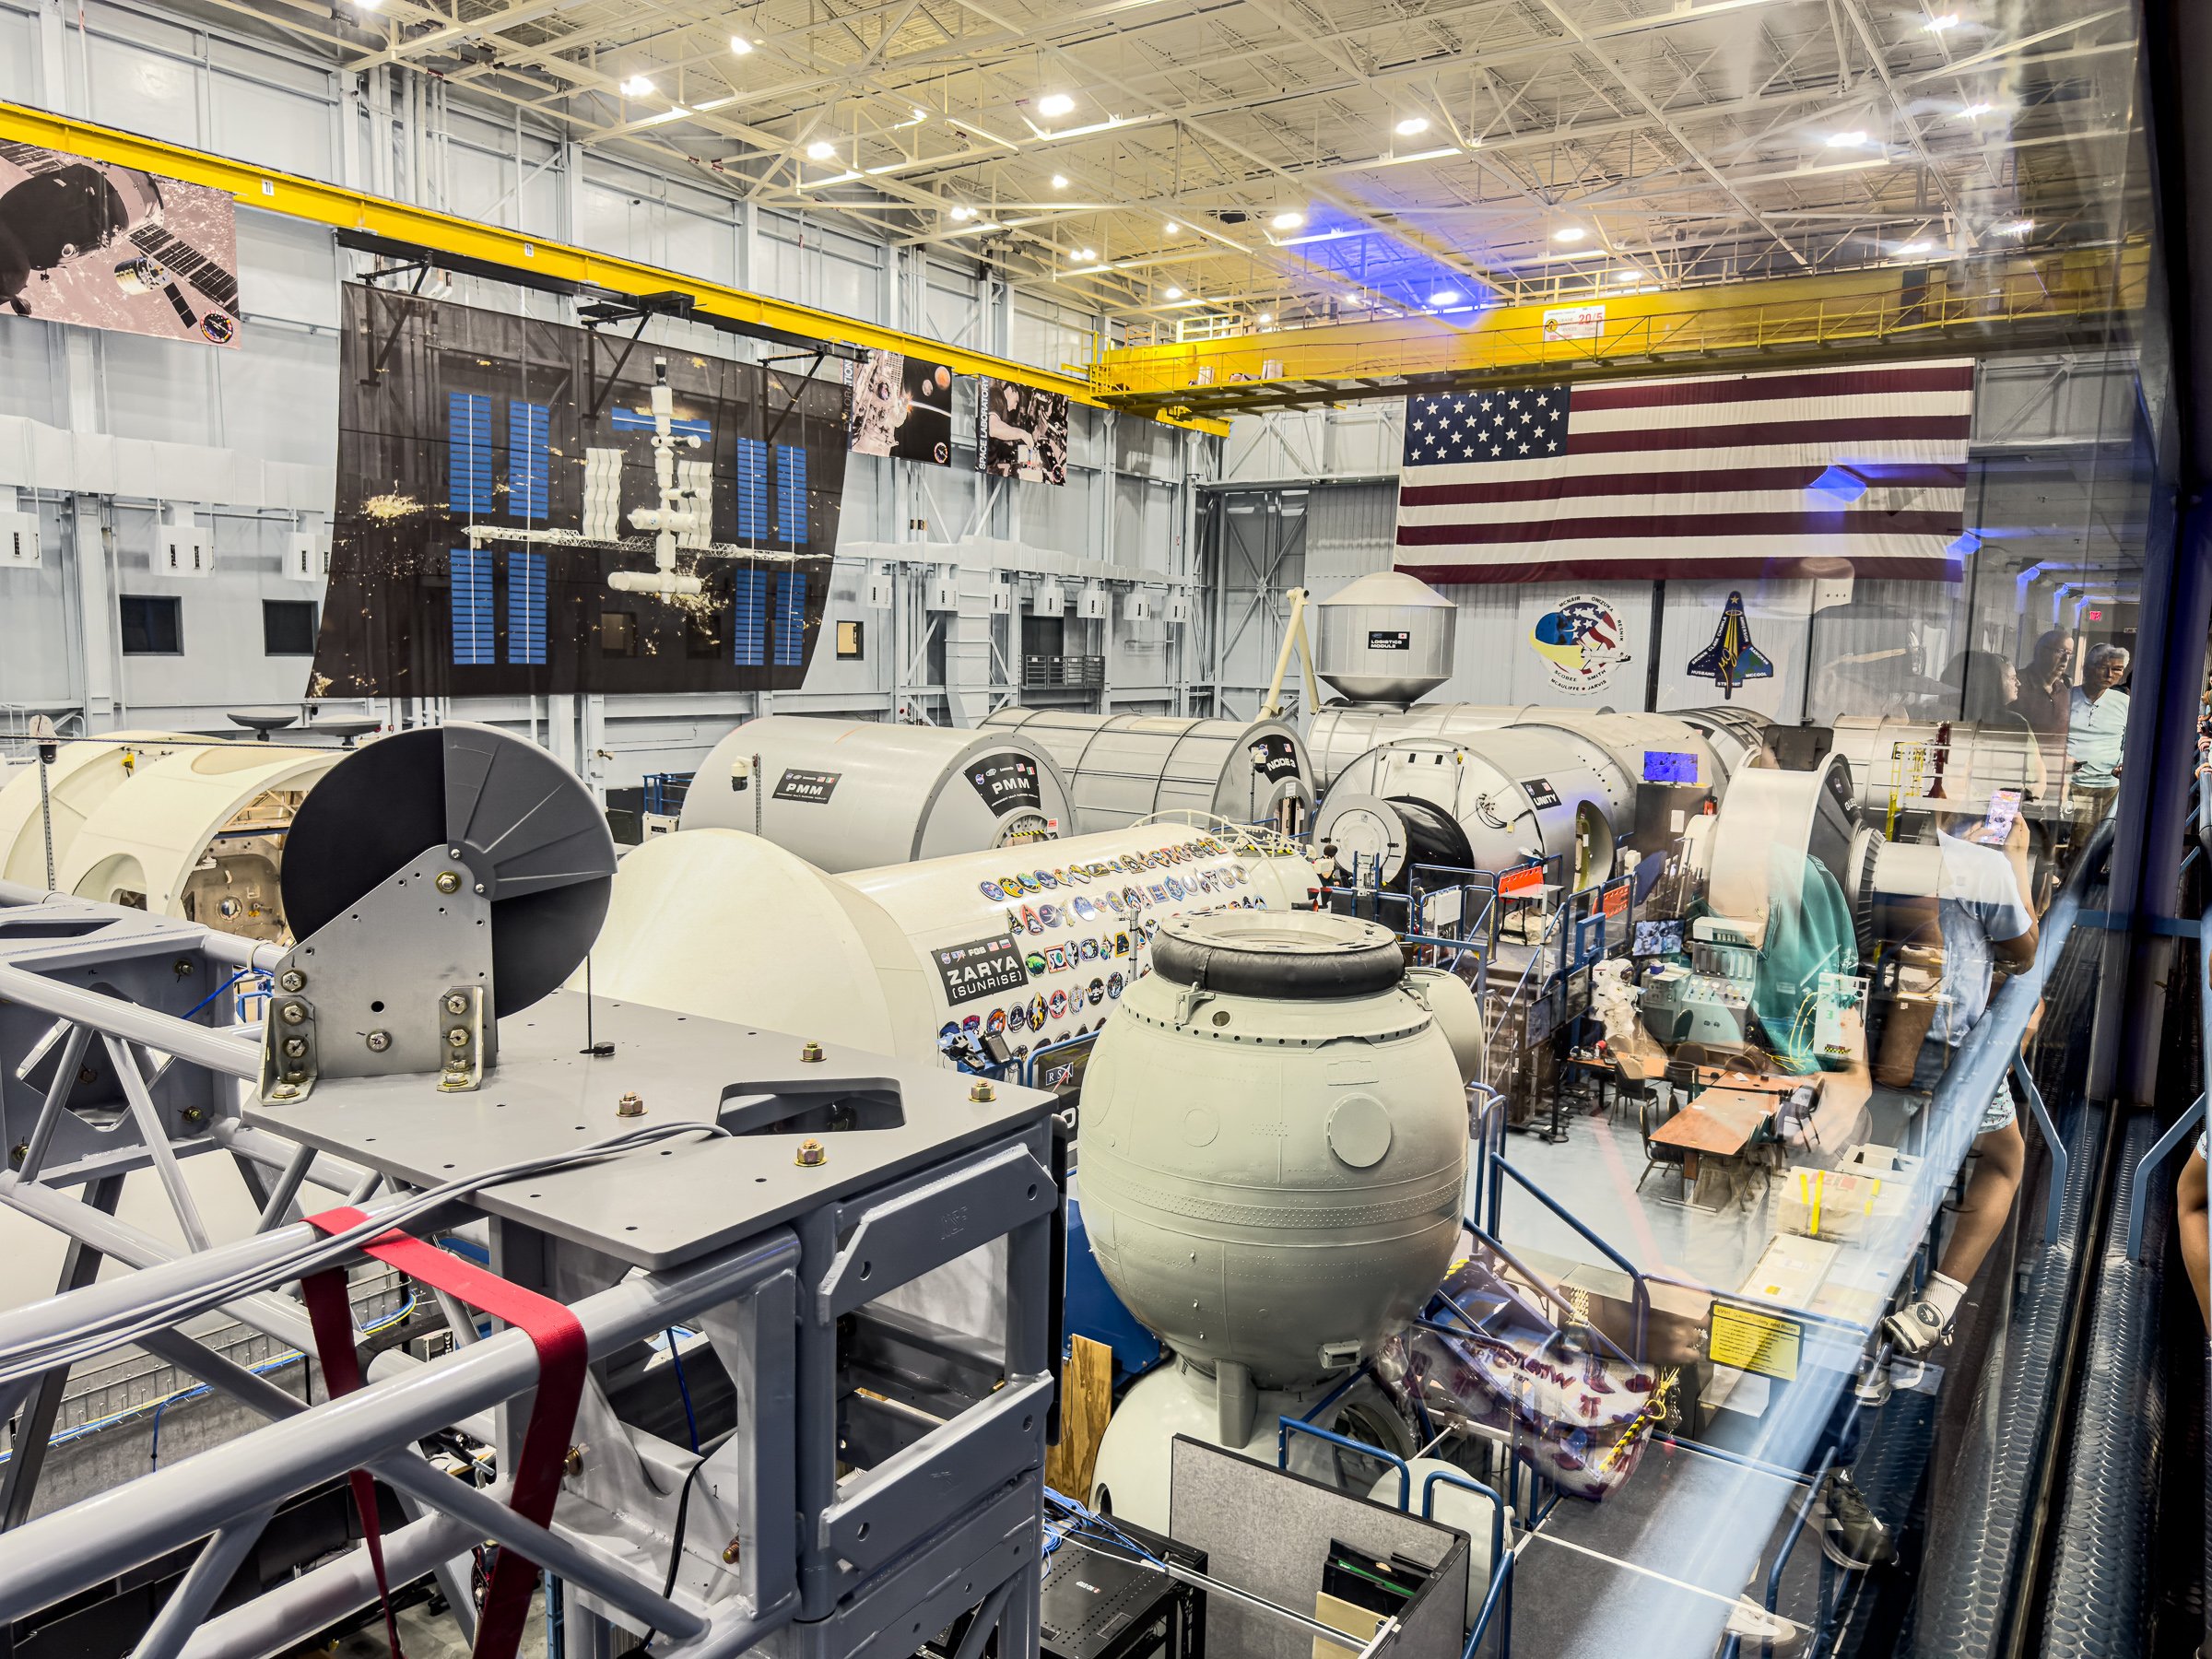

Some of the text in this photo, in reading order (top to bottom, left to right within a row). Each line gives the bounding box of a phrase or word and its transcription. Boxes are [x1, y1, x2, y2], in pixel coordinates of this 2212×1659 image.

[979, 378, 990, 470] SPACE LABORATORY
[1559, 595, 1581, 607] MCNAIR
[1591, 596, 1614, 613] ONIZUKA
[1717, 617, 1727, 637] CHAWLA
[1554, 669, 1606, 682] SCOBEE SMITH
[1550, 678, 1607, 691] MCAULIFFE JARVIS
[785, 782, 824, 795] PMM
[992, 777, 1030, 794] PMM
[1533, 794, 1557, 806] UNITY
[968, 946, 987, 957] FGB
[947, 955, 1019, 986] ZARYA
[952, 971, 1022, 999] (SUNRISE)
